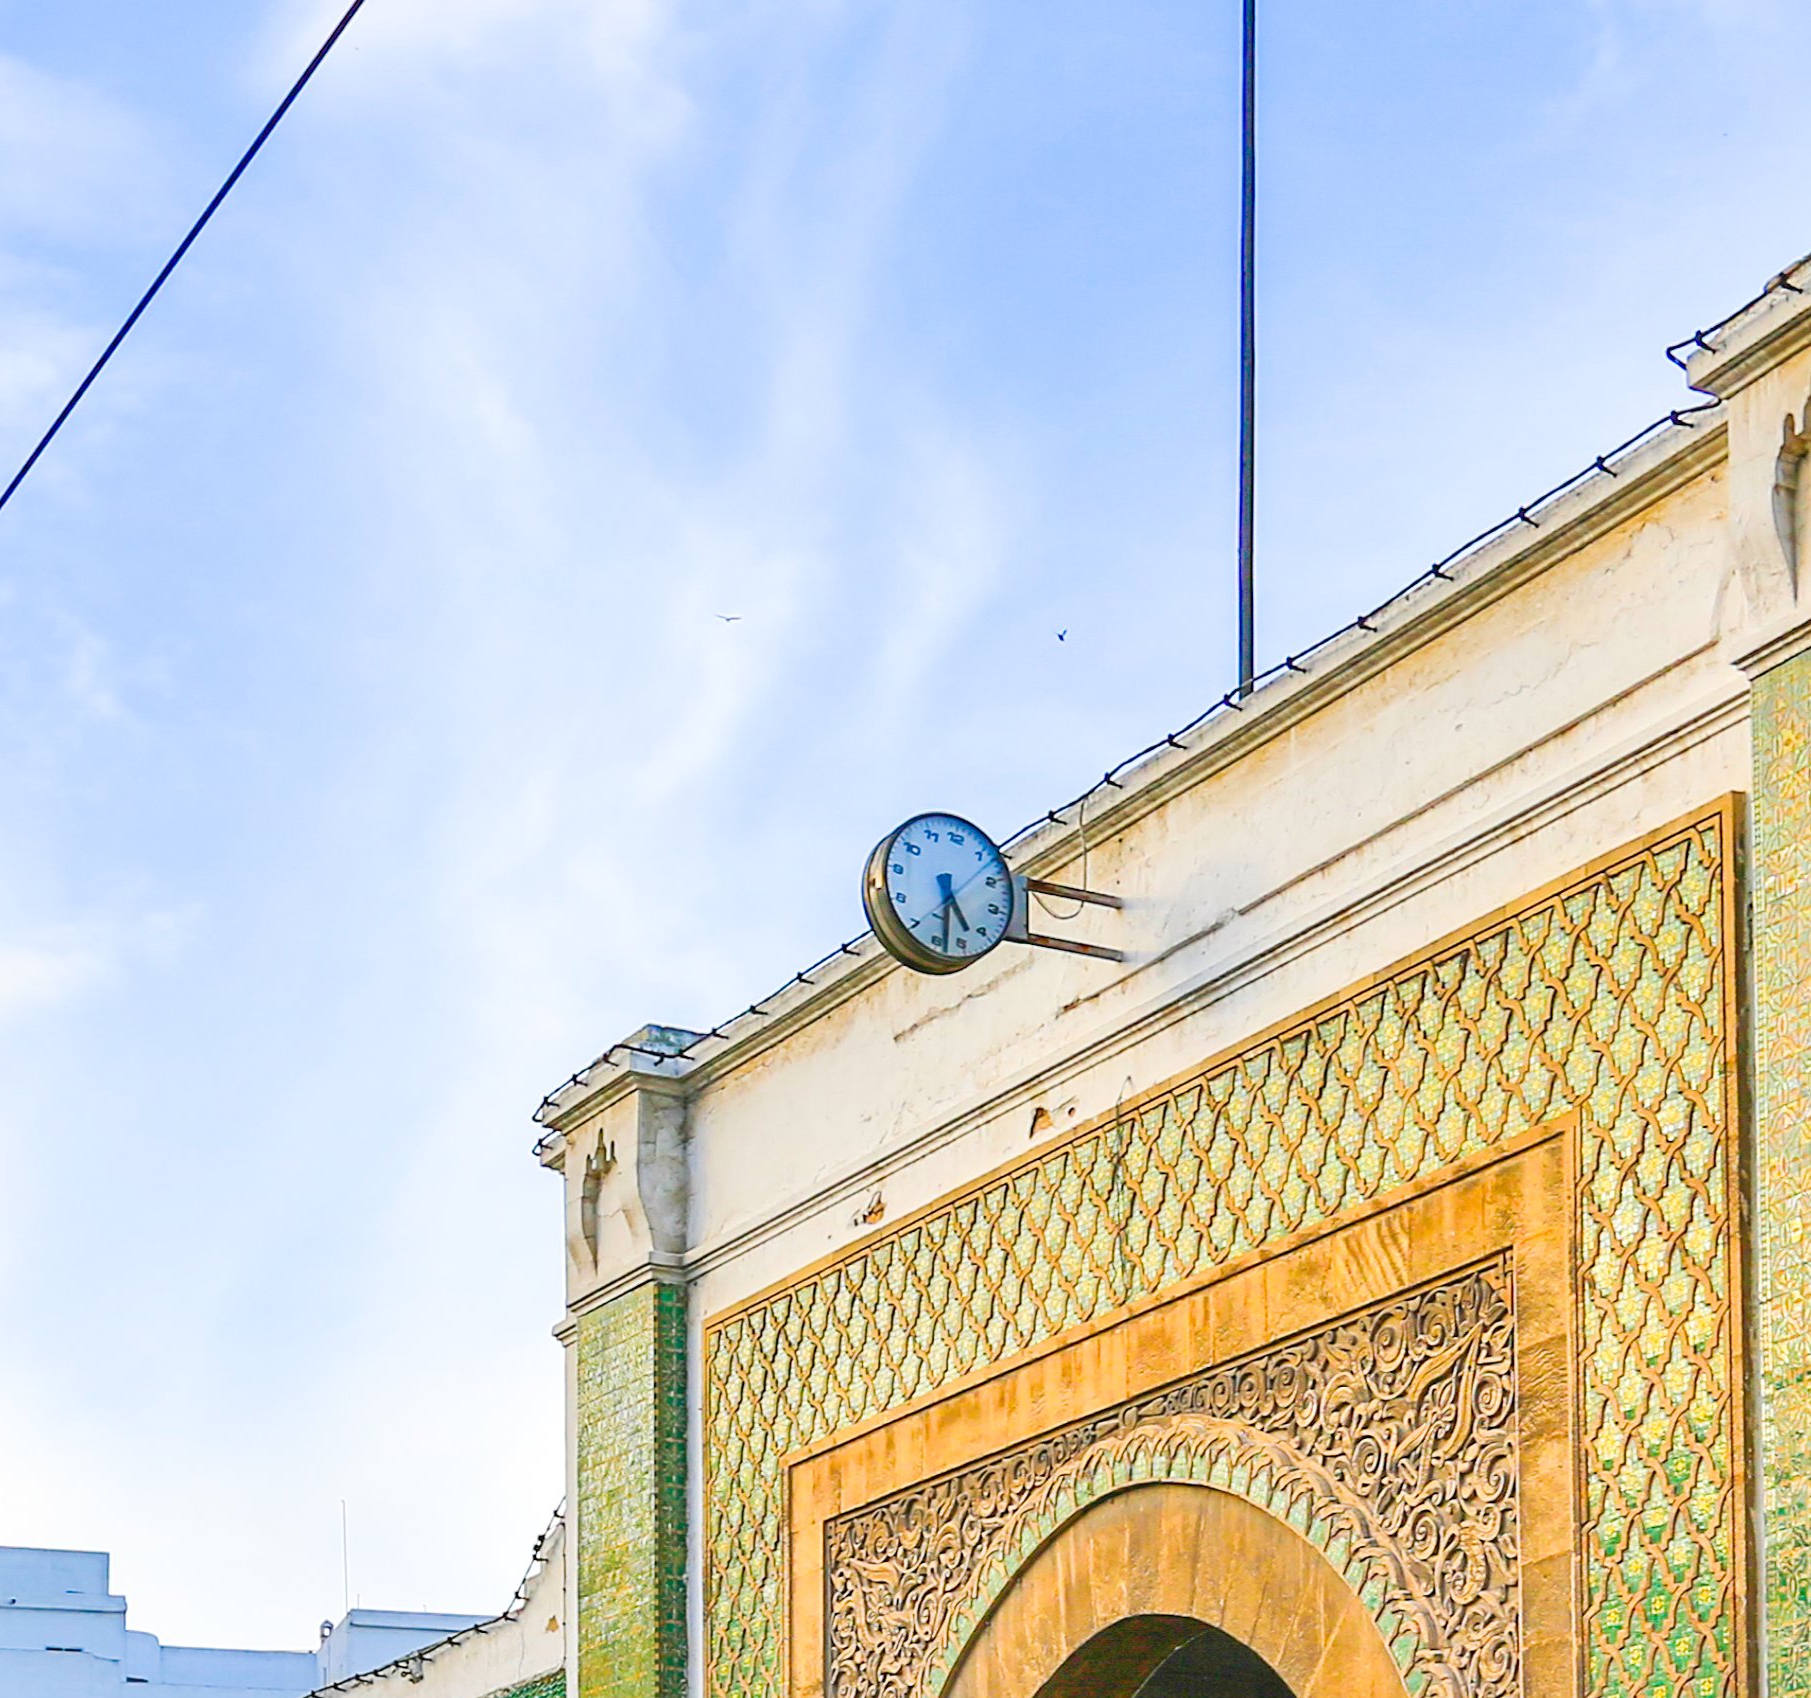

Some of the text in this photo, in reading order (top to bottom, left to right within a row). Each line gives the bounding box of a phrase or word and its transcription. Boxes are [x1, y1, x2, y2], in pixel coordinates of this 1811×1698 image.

[924, 829, 939, 843] 11
[947, 831, 965, 846] 12
[903, 841, 921, 856] 10
[975, 851, 983, 862] 1
[893, 863, 904, 875] 9
[986, 876, 997, 888] 2
[895, 892, 907, 904] 8
[988, 903, 1000, 915] 3
[910, 918, 920, 929] 7
[976, 926, 987, 938] 4
[931, 935, 942, 946] 6
[956, 937, 967, 949] 5
